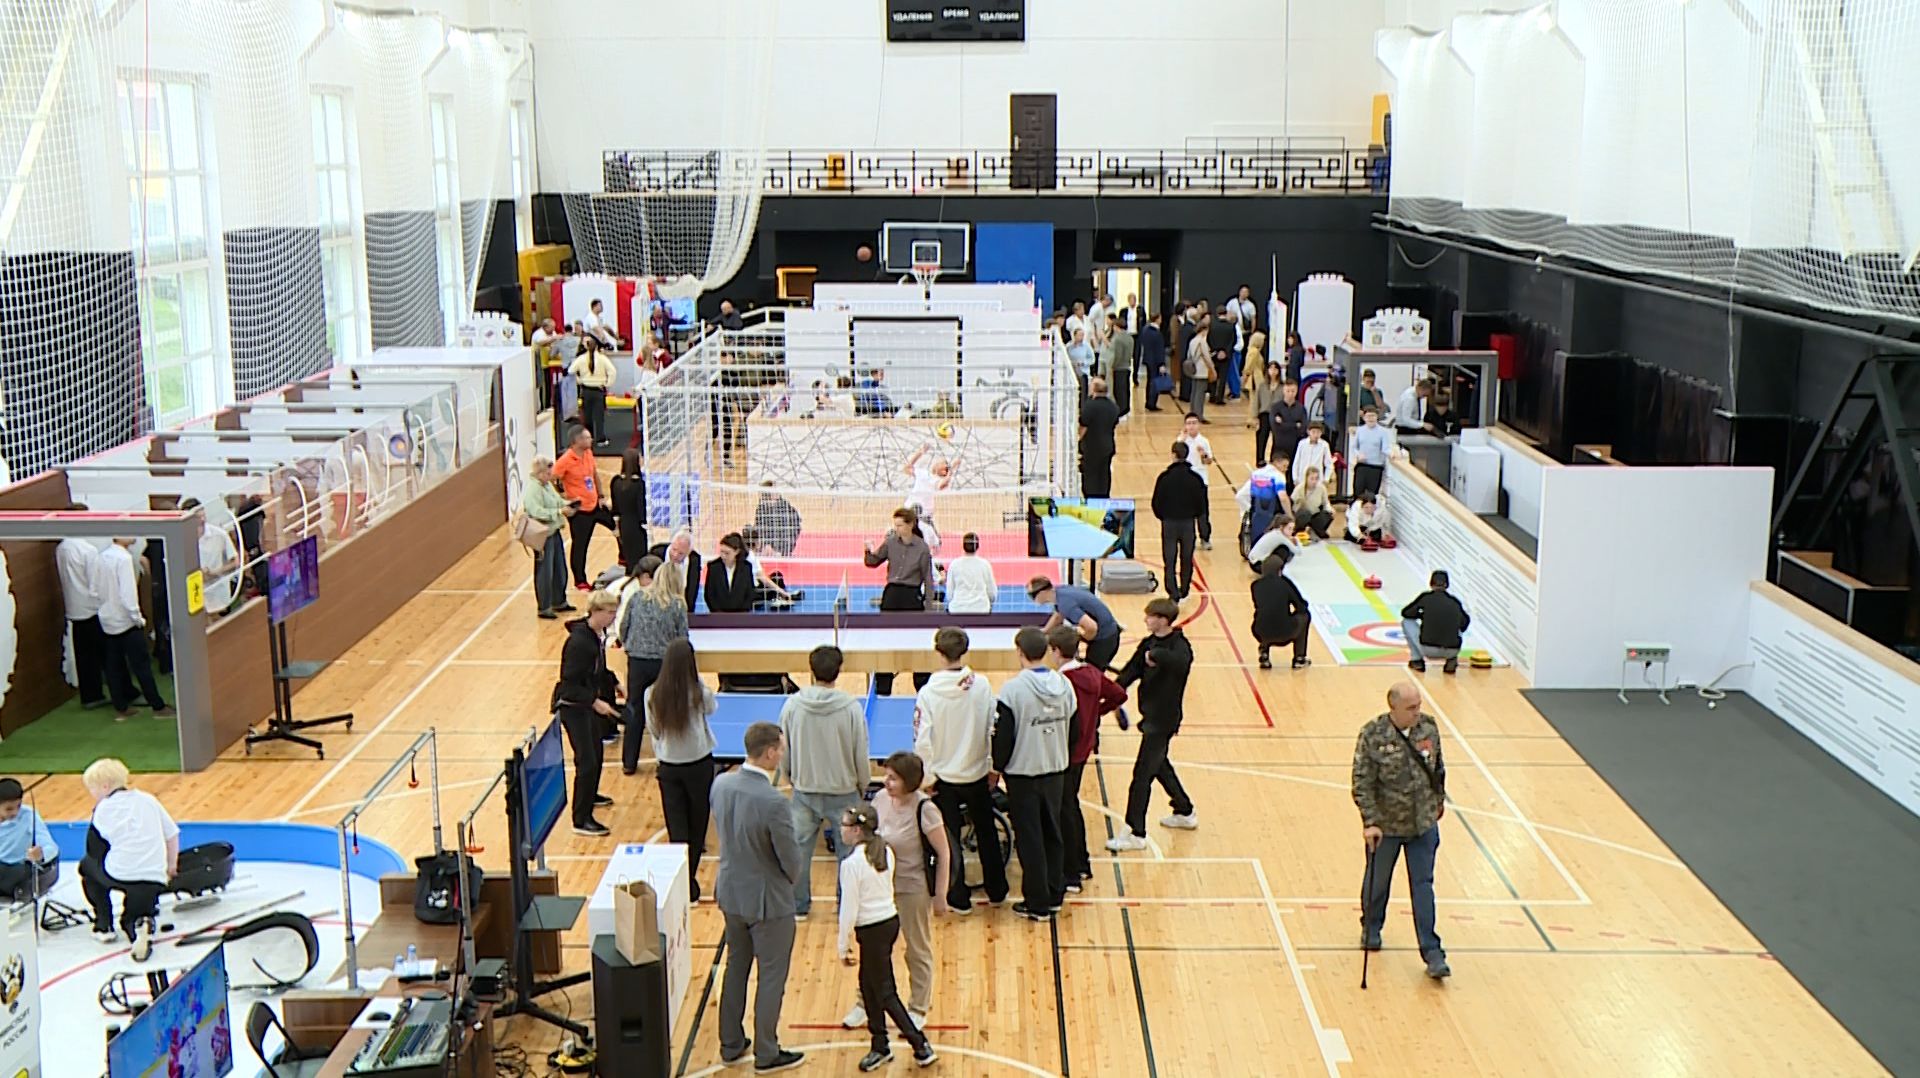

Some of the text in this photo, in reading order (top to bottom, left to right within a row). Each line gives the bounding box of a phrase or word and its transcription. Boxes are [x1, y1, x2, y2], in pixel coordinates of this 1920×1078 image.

[893, 9, 1019, 21] УДАЛЕНИЯ ВРЕМЯ УДАЛЕНИЯ
